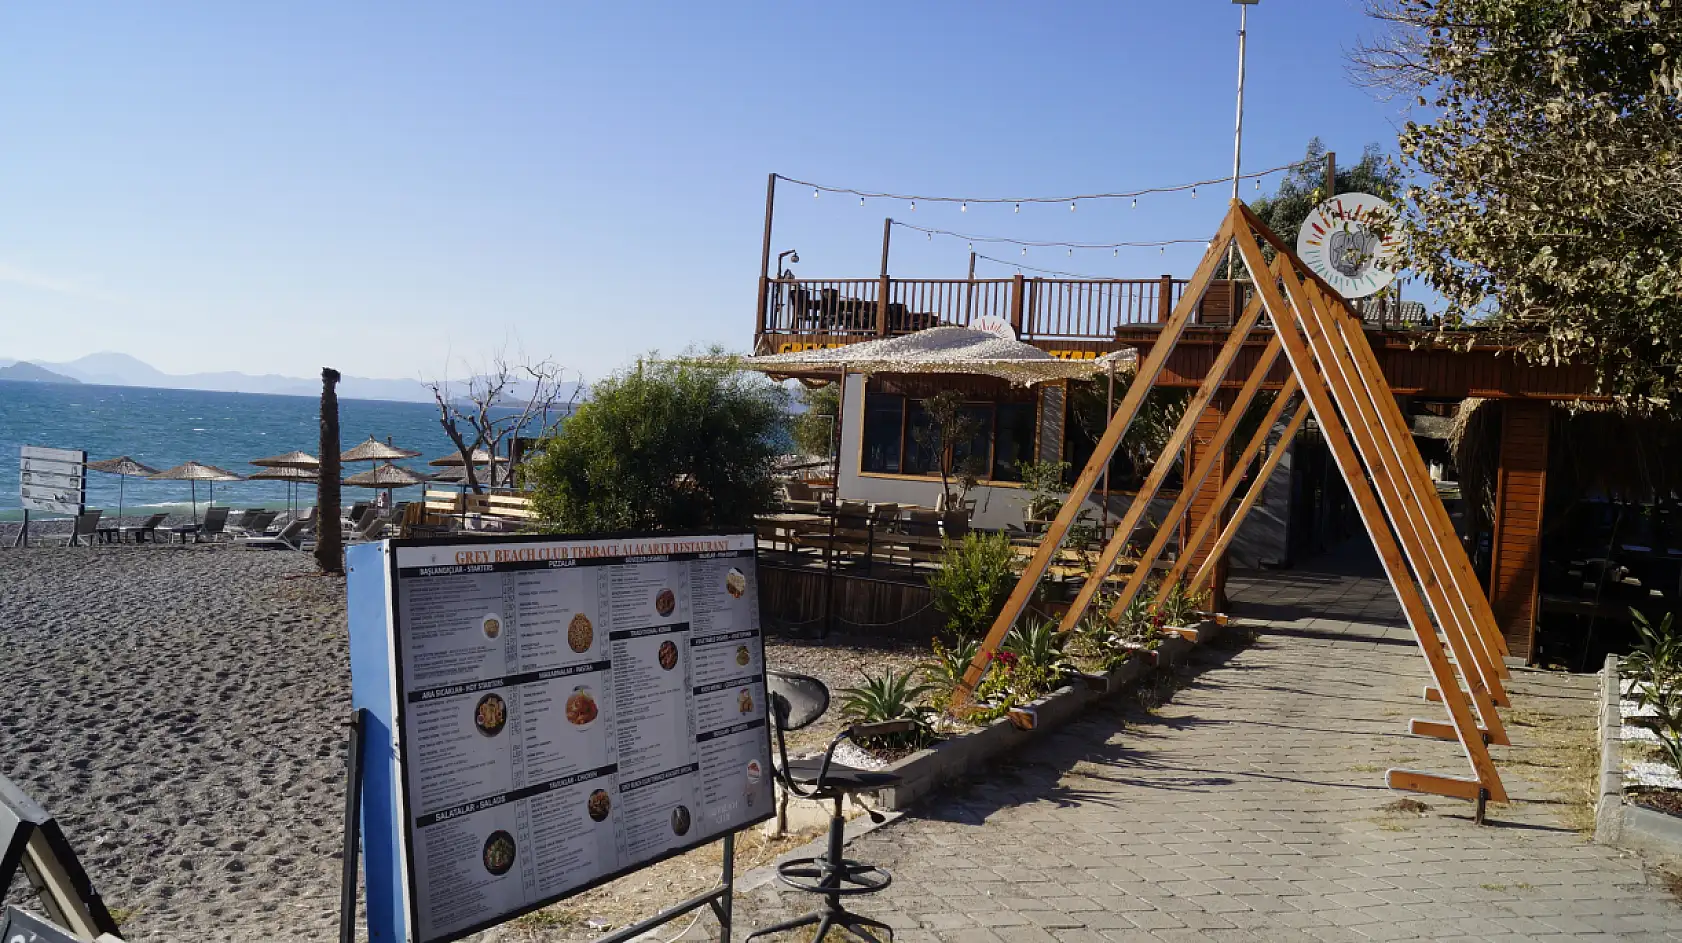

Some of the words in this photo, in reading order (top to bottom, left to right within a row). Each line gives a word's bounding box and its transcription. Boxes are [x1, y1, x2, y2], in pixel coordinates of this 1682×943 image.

[455, 550, 491, 565] GREY
[494, 548, 535, 562] BEACH
[538, 547, 569, 561] CLUB
[571, 545, 619, 559] TERRACE
[622, 542, 670, 556] ALACARTE
[673, 540, 728, 553] RESTAURANT
[467, 564, 493, 573] STARTERS
[435, 804, 475, 822] SALATALAR
[479, 795, 506, 809] SALADS
